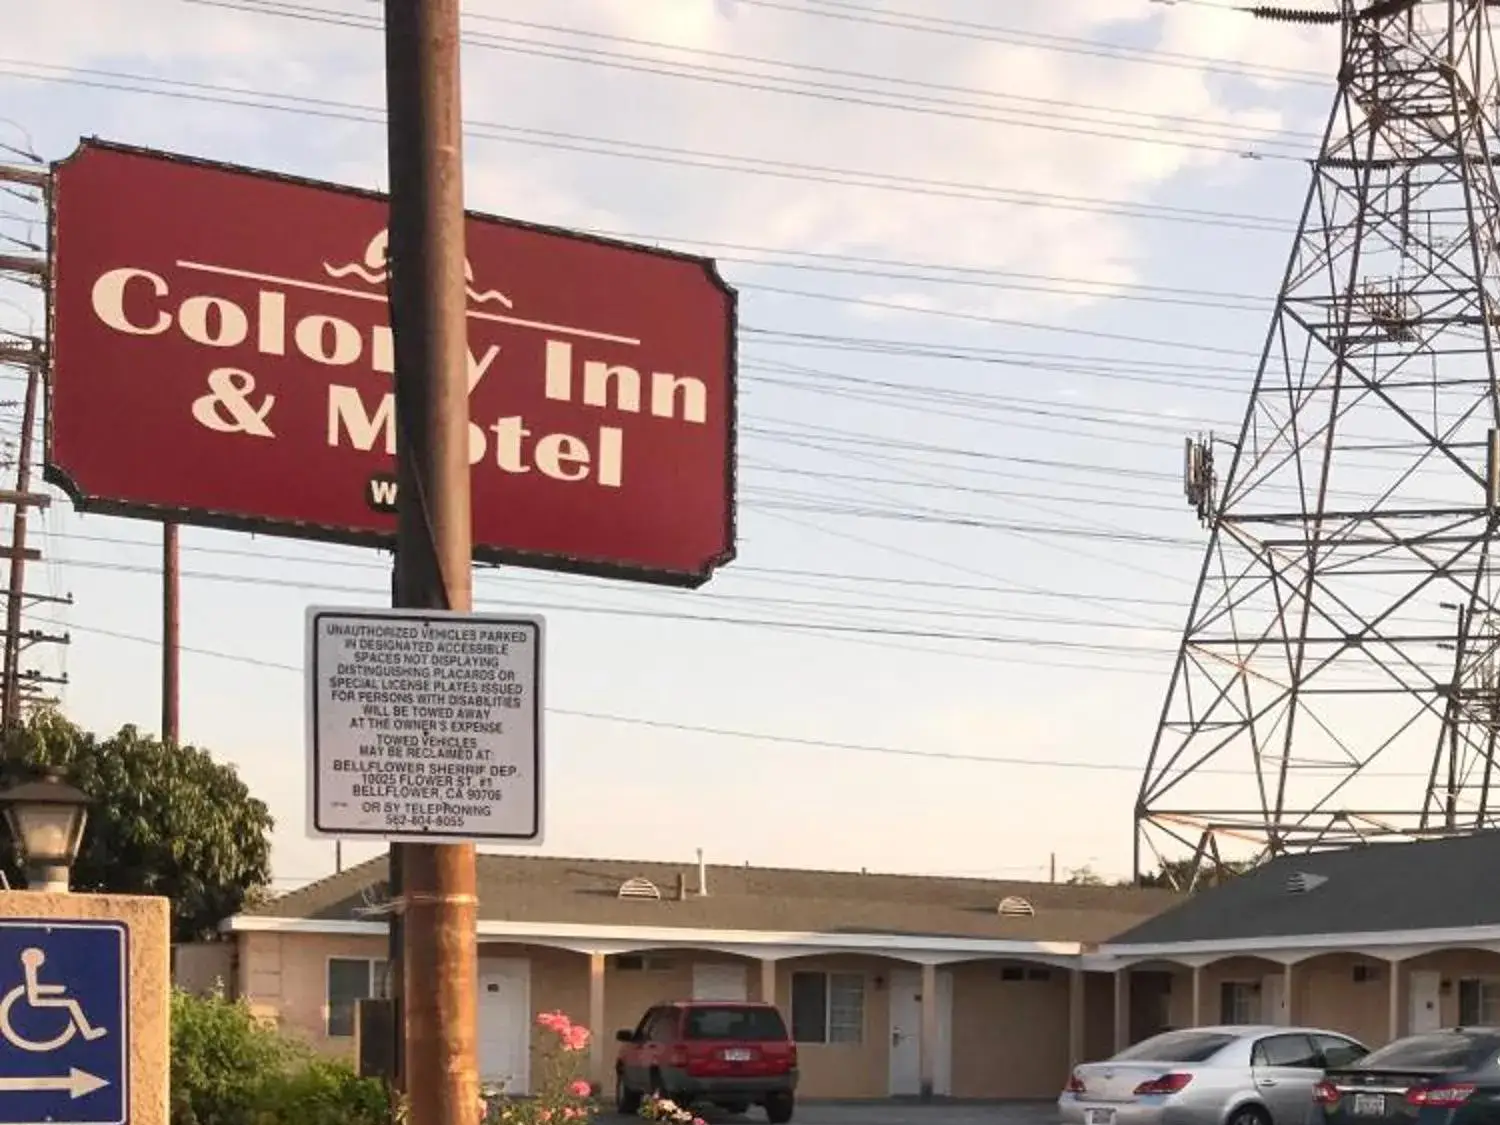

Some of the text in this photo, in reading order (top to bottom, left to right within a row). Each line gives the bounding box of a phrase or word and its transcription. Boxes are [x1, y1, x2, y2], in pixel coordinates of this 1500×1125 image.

[91, 267, 707, 423] Coloy Inn
[191, 367, 623, 487] & Mtel
[327, 624, 527, 643] UNAUTHORIZED VEHICLES PARKED
[345, 638, 509, 655] IN DESIGNATED ACCESSIBLE
[354, 652, 499, 668] SPACES NOT DISPLAYING
[337, 664, 515, 681] DISTINGUISHING PLACARDS OR
[329, 677, 523, 695] SPECIAL LICENSE PLATES ISSUED
[332, 691, 521, 709] FOR PERSONS WITH DISABILITIES
[363, 705, 491, 720] WILL BE TOWED AWAY
[349, 718, 368, 729] AT
[370, 718, 389, 730] THE
[451, 722, 503, 734] EXPENSE
[377, 734, 477, 748] TOWED VEHICLES
[360, 746, 384, 757] MAY
[388, 747, 403, 758] BE
[407, 747, 473, 761] RECLAIMED
[333, 760, 424, 774] BELLFLOWER
[400, 774, 453, 787] FLOWER
[446, 787, 463, 799] CA
[361, 802, 380, 813] OR
[384, 803, 399, 814] BY
[405, 802, 491, 816] TELEPHONING
